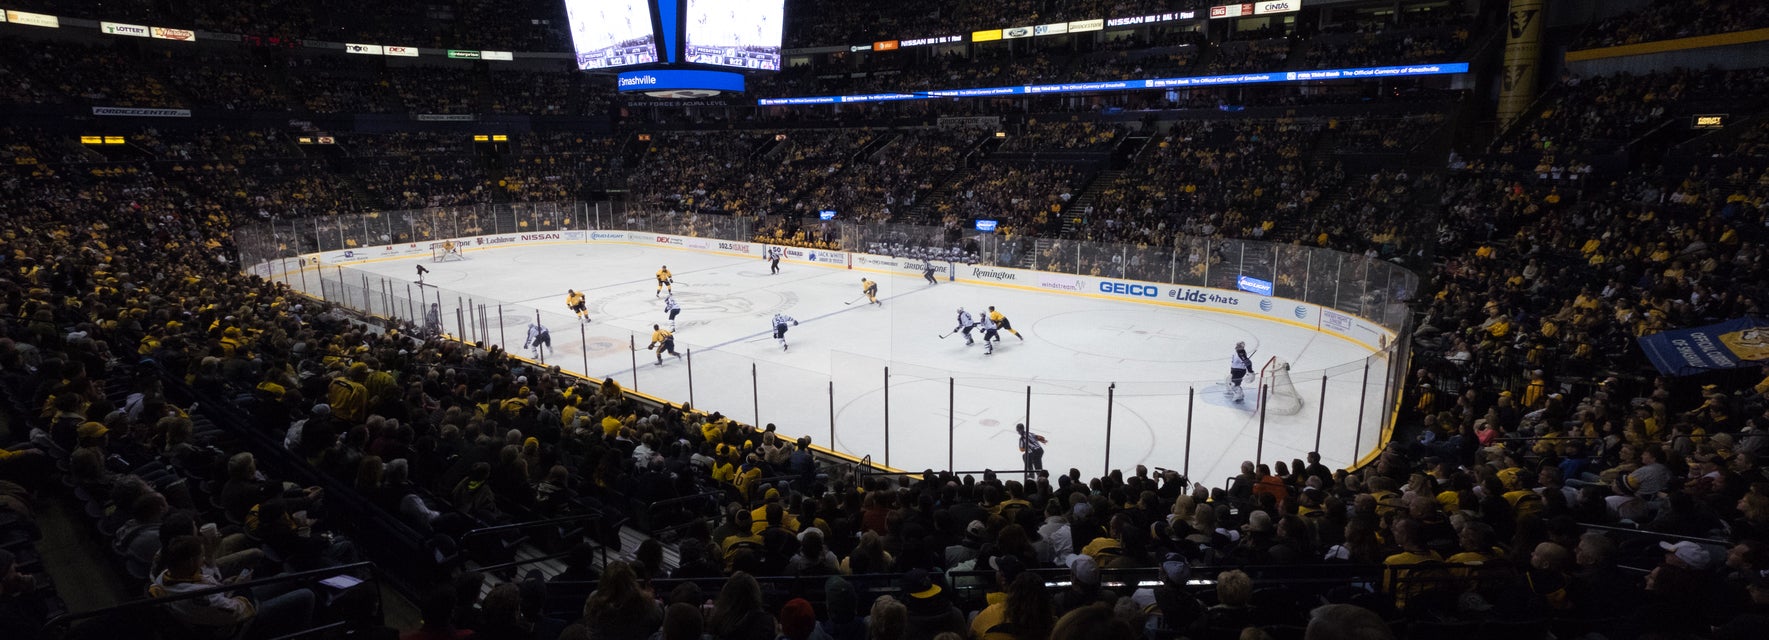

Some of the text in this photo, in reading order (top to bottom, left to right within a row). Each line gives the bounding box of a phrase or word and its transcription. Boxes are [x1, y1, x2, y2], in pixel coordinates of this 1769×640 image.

[1107, 16, 1144, 27] NISSAN
[1175, 12, 1179, 20] 1
[1180, 11, 1194, 19] Final
[116, 25, 145, 34] LOTTERY
[901, 38, 926, 47] NISSAN
[622, 75, 657, 87] Smashville
[521, 233, 561, 242] NISSAN
[656, 236, 670, 244] DEX
[972, 267, 1015, 281] Remington
[1041, 282, 1076, 291] windstream
[1099, 281, 1158, 297] GEICO
[1208, 294, 1239, 306] 4hats
